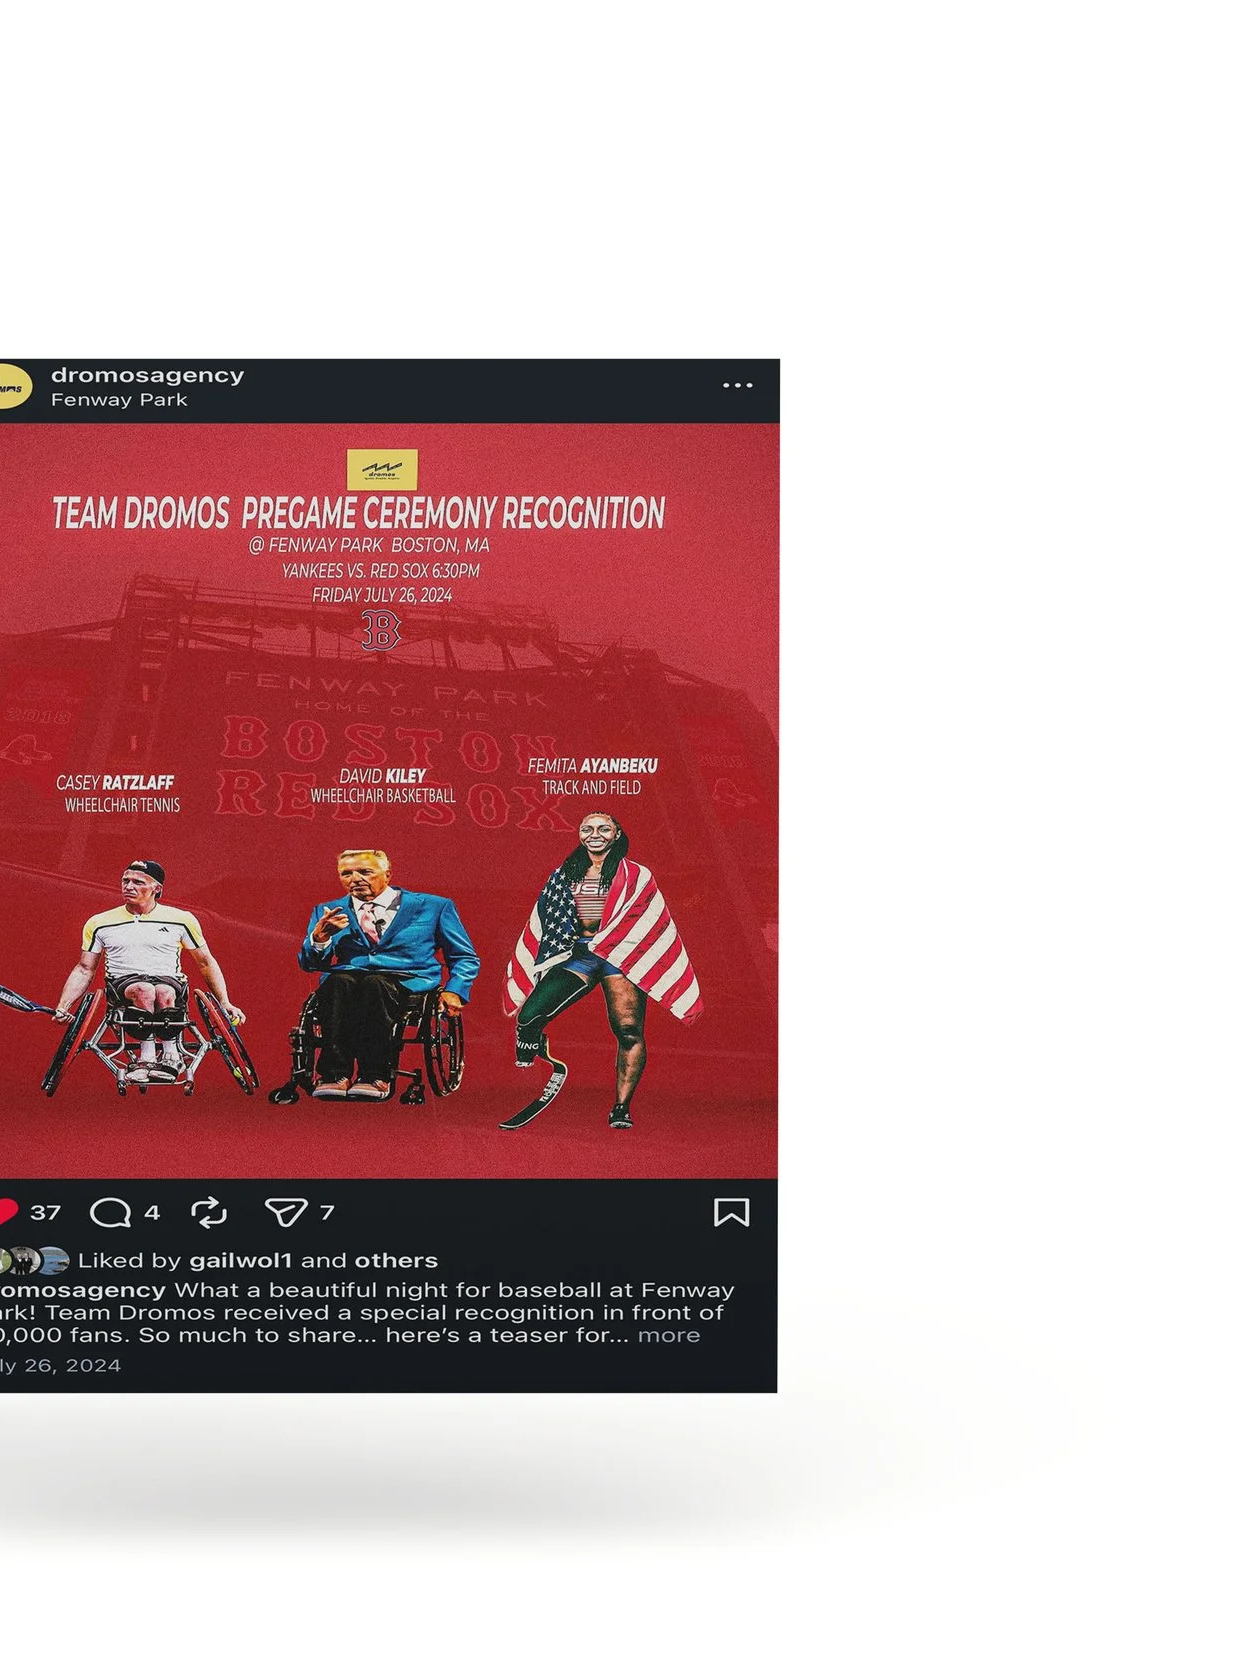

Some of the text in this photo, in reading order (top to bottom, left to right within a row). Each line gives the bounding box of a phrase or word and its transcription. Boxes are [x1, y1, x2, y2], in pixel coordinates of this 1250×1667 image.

[52, 367, 244, 386] dromosagency
[53, 393, 187, 409] Fenway Park
[55, 496, 665, 529] TEAM DROMOS PREGAME CEREMONY RECOGNITION
[250, 536, 489, 555] @ FENWAY PARK BOSTON, MA
[283, 563, 480, 578] YANKEES VS. RED SOX 6:30PM
[313, 587, 452, 605] FRIDAY JULY 26, 2024
[225, 671, 547, 708] FENWAY PARK
[220, 715, 558, 777] BOSTON
[528, 758, 658, 773] FEMITA AYANBEKU
[57, 775, 174, 790] CASEY RATZLAFF
[340, 769, 426, 783] DAVID KILEY
[543, 780, 641, 794] TRACK AND FIELD
[311, 788, 456, 803] WHEELCHAIR BASKETBALL
[65, 798, 180, 812] WHEELCHAIR TENNIS
[31, 1205, 60, 1220] 37
[145, 1206, 160, 1220] 4
[321, 1206, 334, 1220] 7
[175, 1282, 238, 1297] What
[248, 1286, 259, 1297] a
[270, 1282, 376, 1297] beautiful
[387, 1282, 447, 1301] night
[456, 1282, 490, 1297] for
[500, 1282, 600, 1297] baseball
[610, 1284, 632, 1297] at
[643, 1283, 734, 1301] Fenway
[45, 1305, 109, 1320] Team
[120, 1305, 215, 1320] Dromos
[225, 1305, 328, 1320] received
[339, 1309, 350, 1320] a
[361, 1305, 445, 1323] special
[456, 1305, 593, 1323] recognition
[604, 1305, 623, 1320] in
[632, 1305, 690, 1320] front
[700, 1305, 724, 1320] of
[70, 1327, 129, 1342] fans.
[140, 1328, 169, 1342] So
[180, 1327, 246, 1342] much
[256, 1329, 278, 1342] to
[289, 1327, 375, 1342] share...
[387, 1327, 459, 1342] here's
[469, 1331, 481, 1342] a
[490, 1329, 568, 1342] teaser
[576, 1327, 628, 1342] for...
[639, 1331, 700, 1342] more
[26, 1359, 56, 1375] 26,
[67, 1359, 121, 1372] 2024
